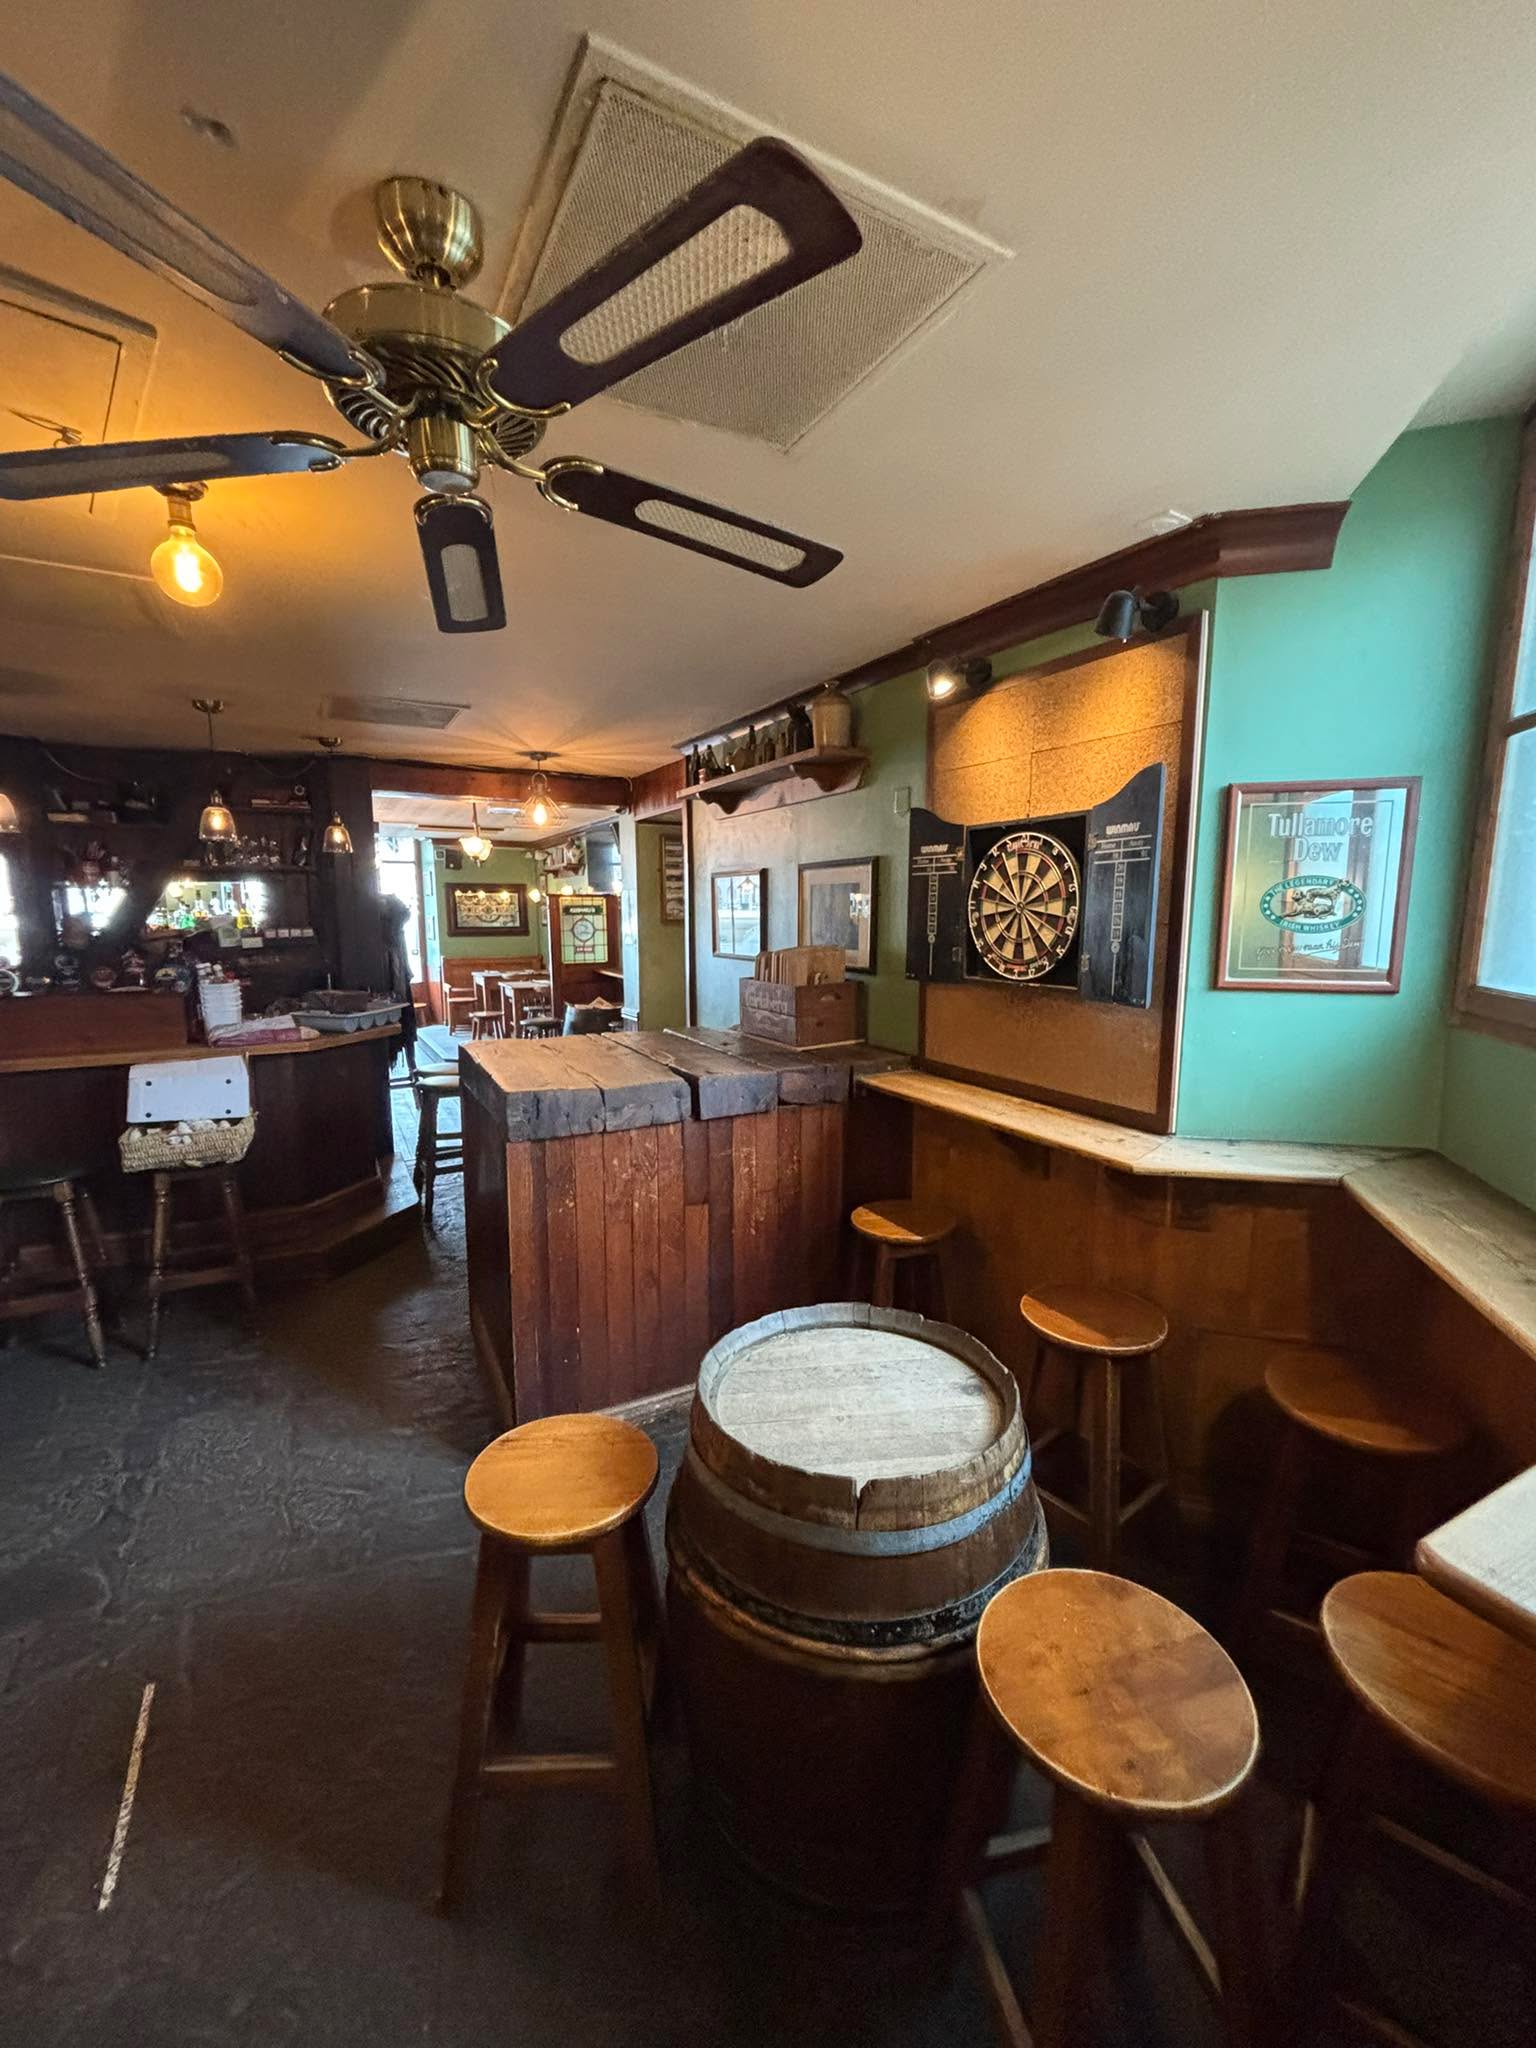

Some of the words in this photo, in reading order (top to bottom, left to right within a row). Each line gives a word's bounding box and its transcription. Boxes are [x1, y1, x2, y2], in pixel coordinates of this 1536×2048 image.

[1267, 812, 1374, 837] Tullamore
[1293, 837, 1343, 862] Dew
[1285, 877, 1334, 890] LEGENDARY
[1280, 919, 1302, 930] IRISH
[1302, 920, 1341, 932] WHISKEY
